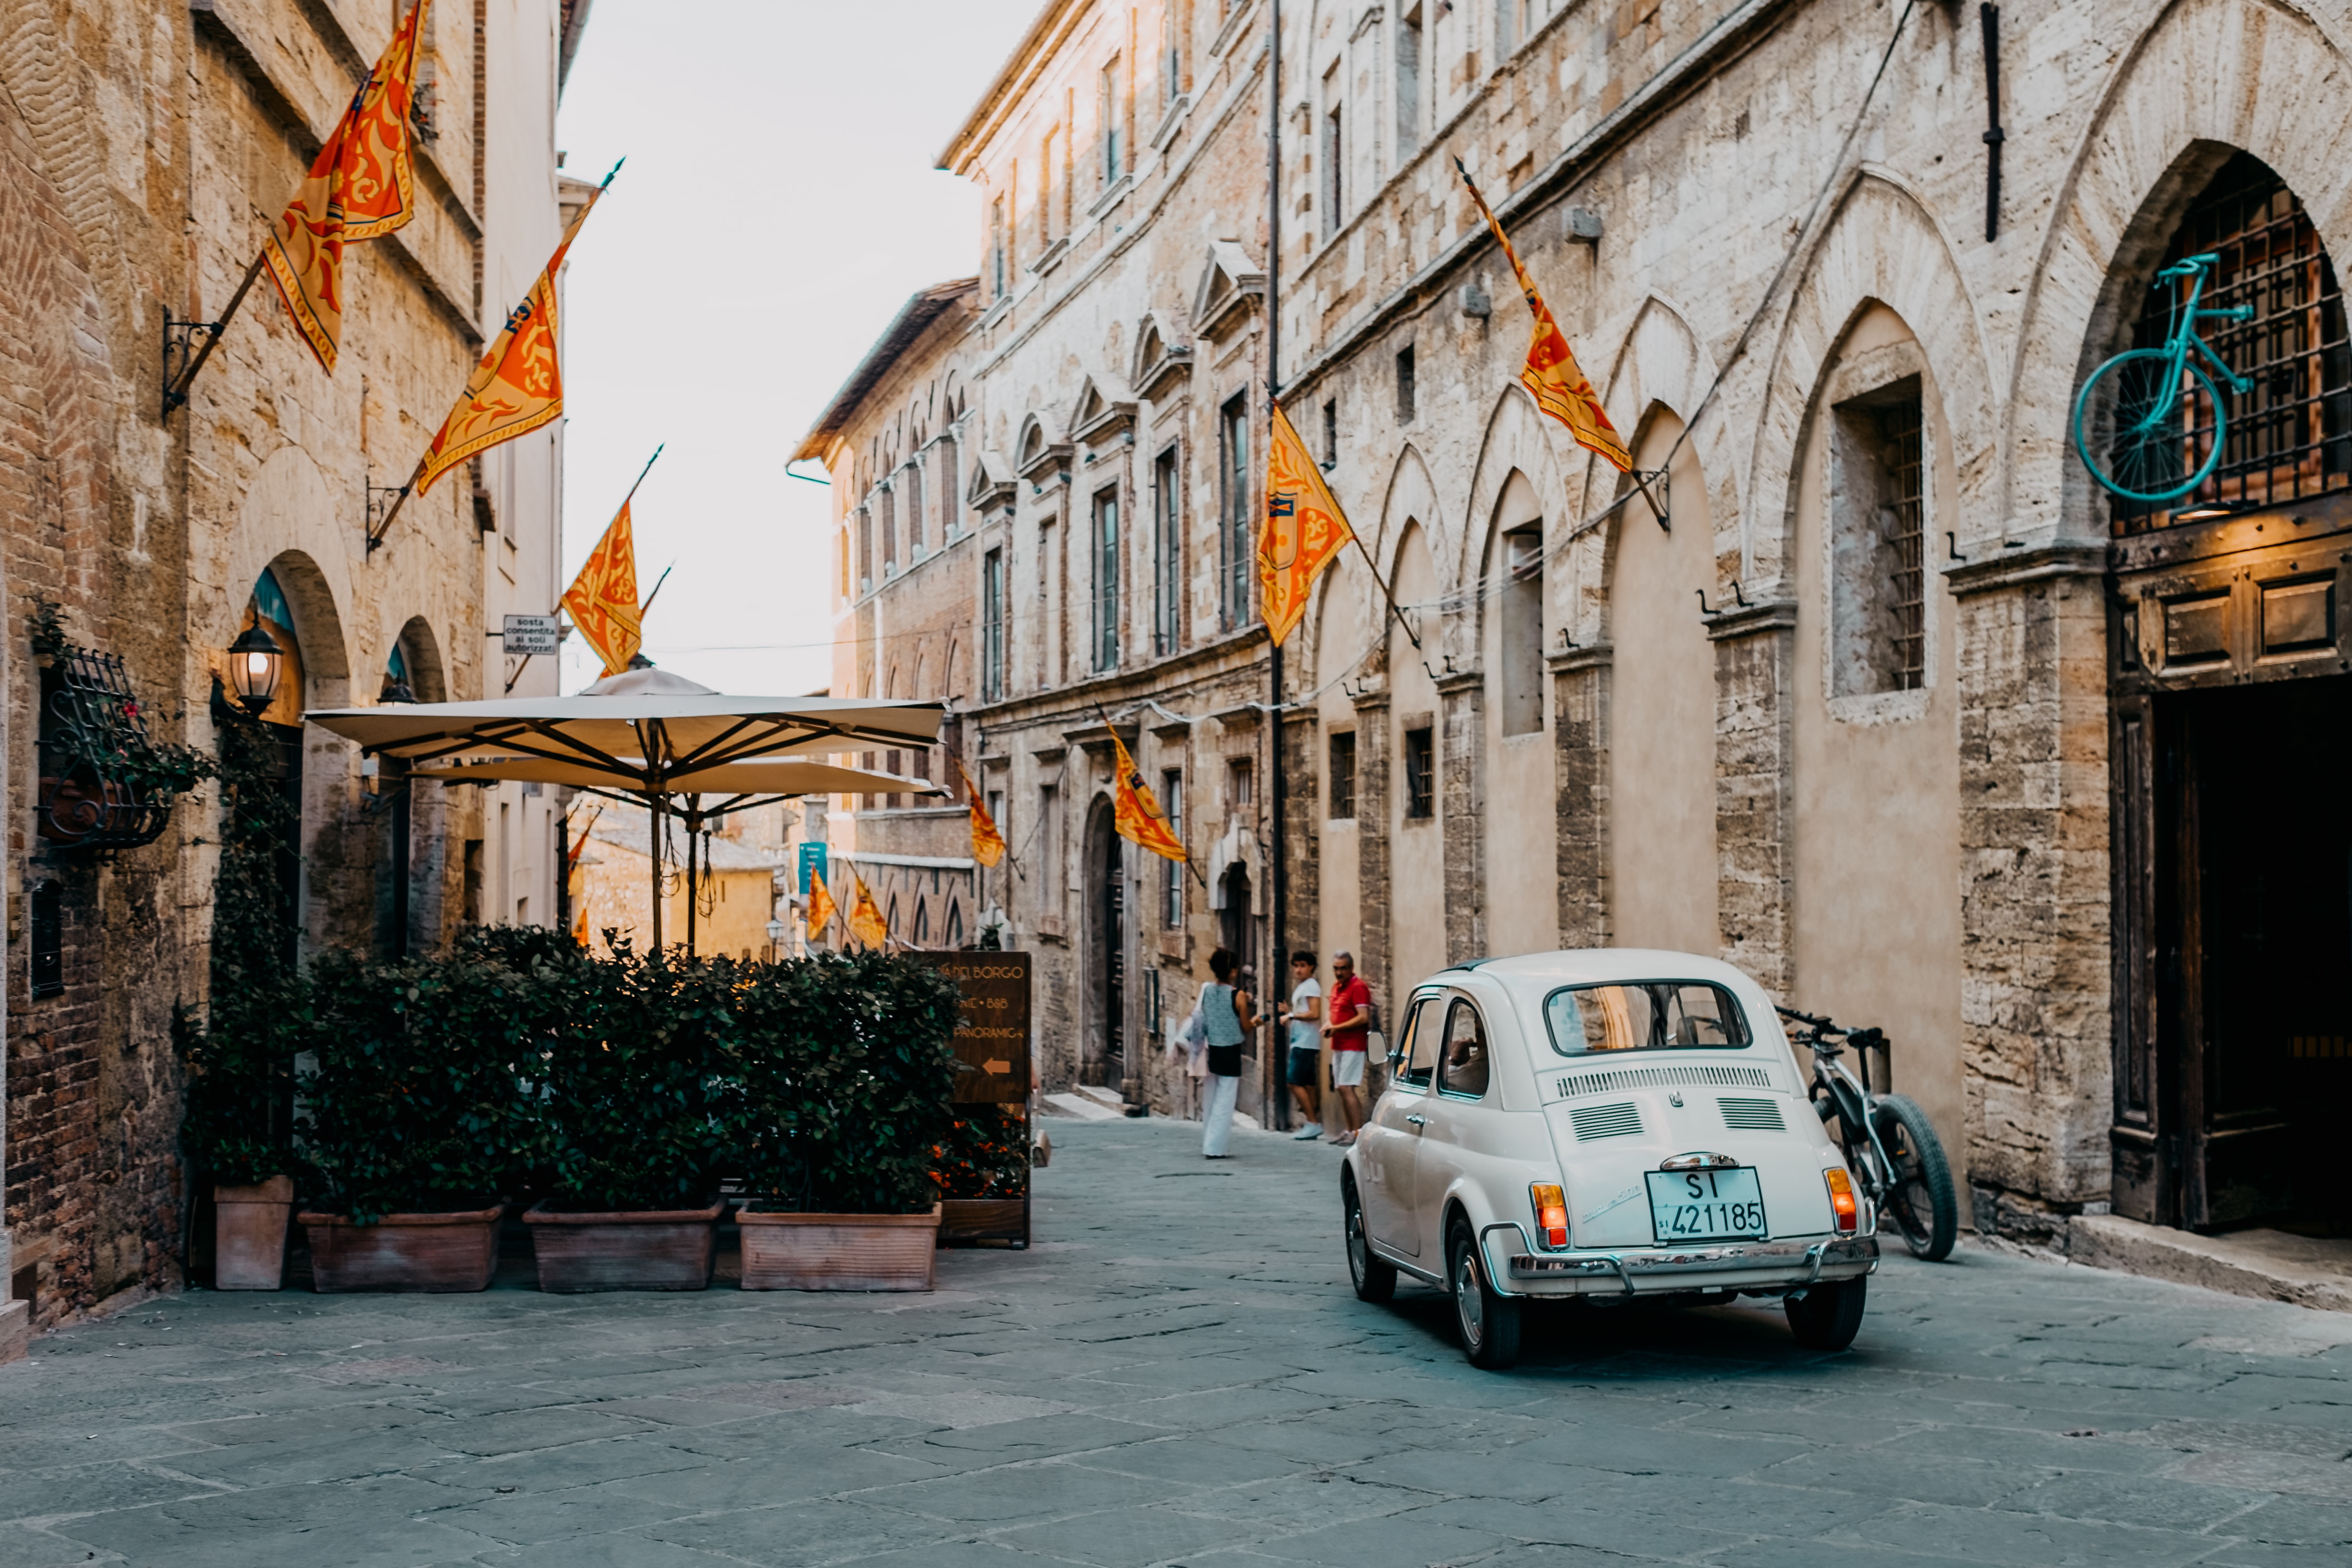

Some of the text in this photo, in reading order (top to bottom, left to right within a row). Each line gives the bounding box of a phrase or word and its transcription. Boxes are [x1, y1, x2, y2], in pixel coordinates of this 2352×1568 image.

[973, 967, 1024, 979] BORGO
[1686, 1173, 1718, 1199] SI
[1672, 1203, 1762, 1234] 421185
